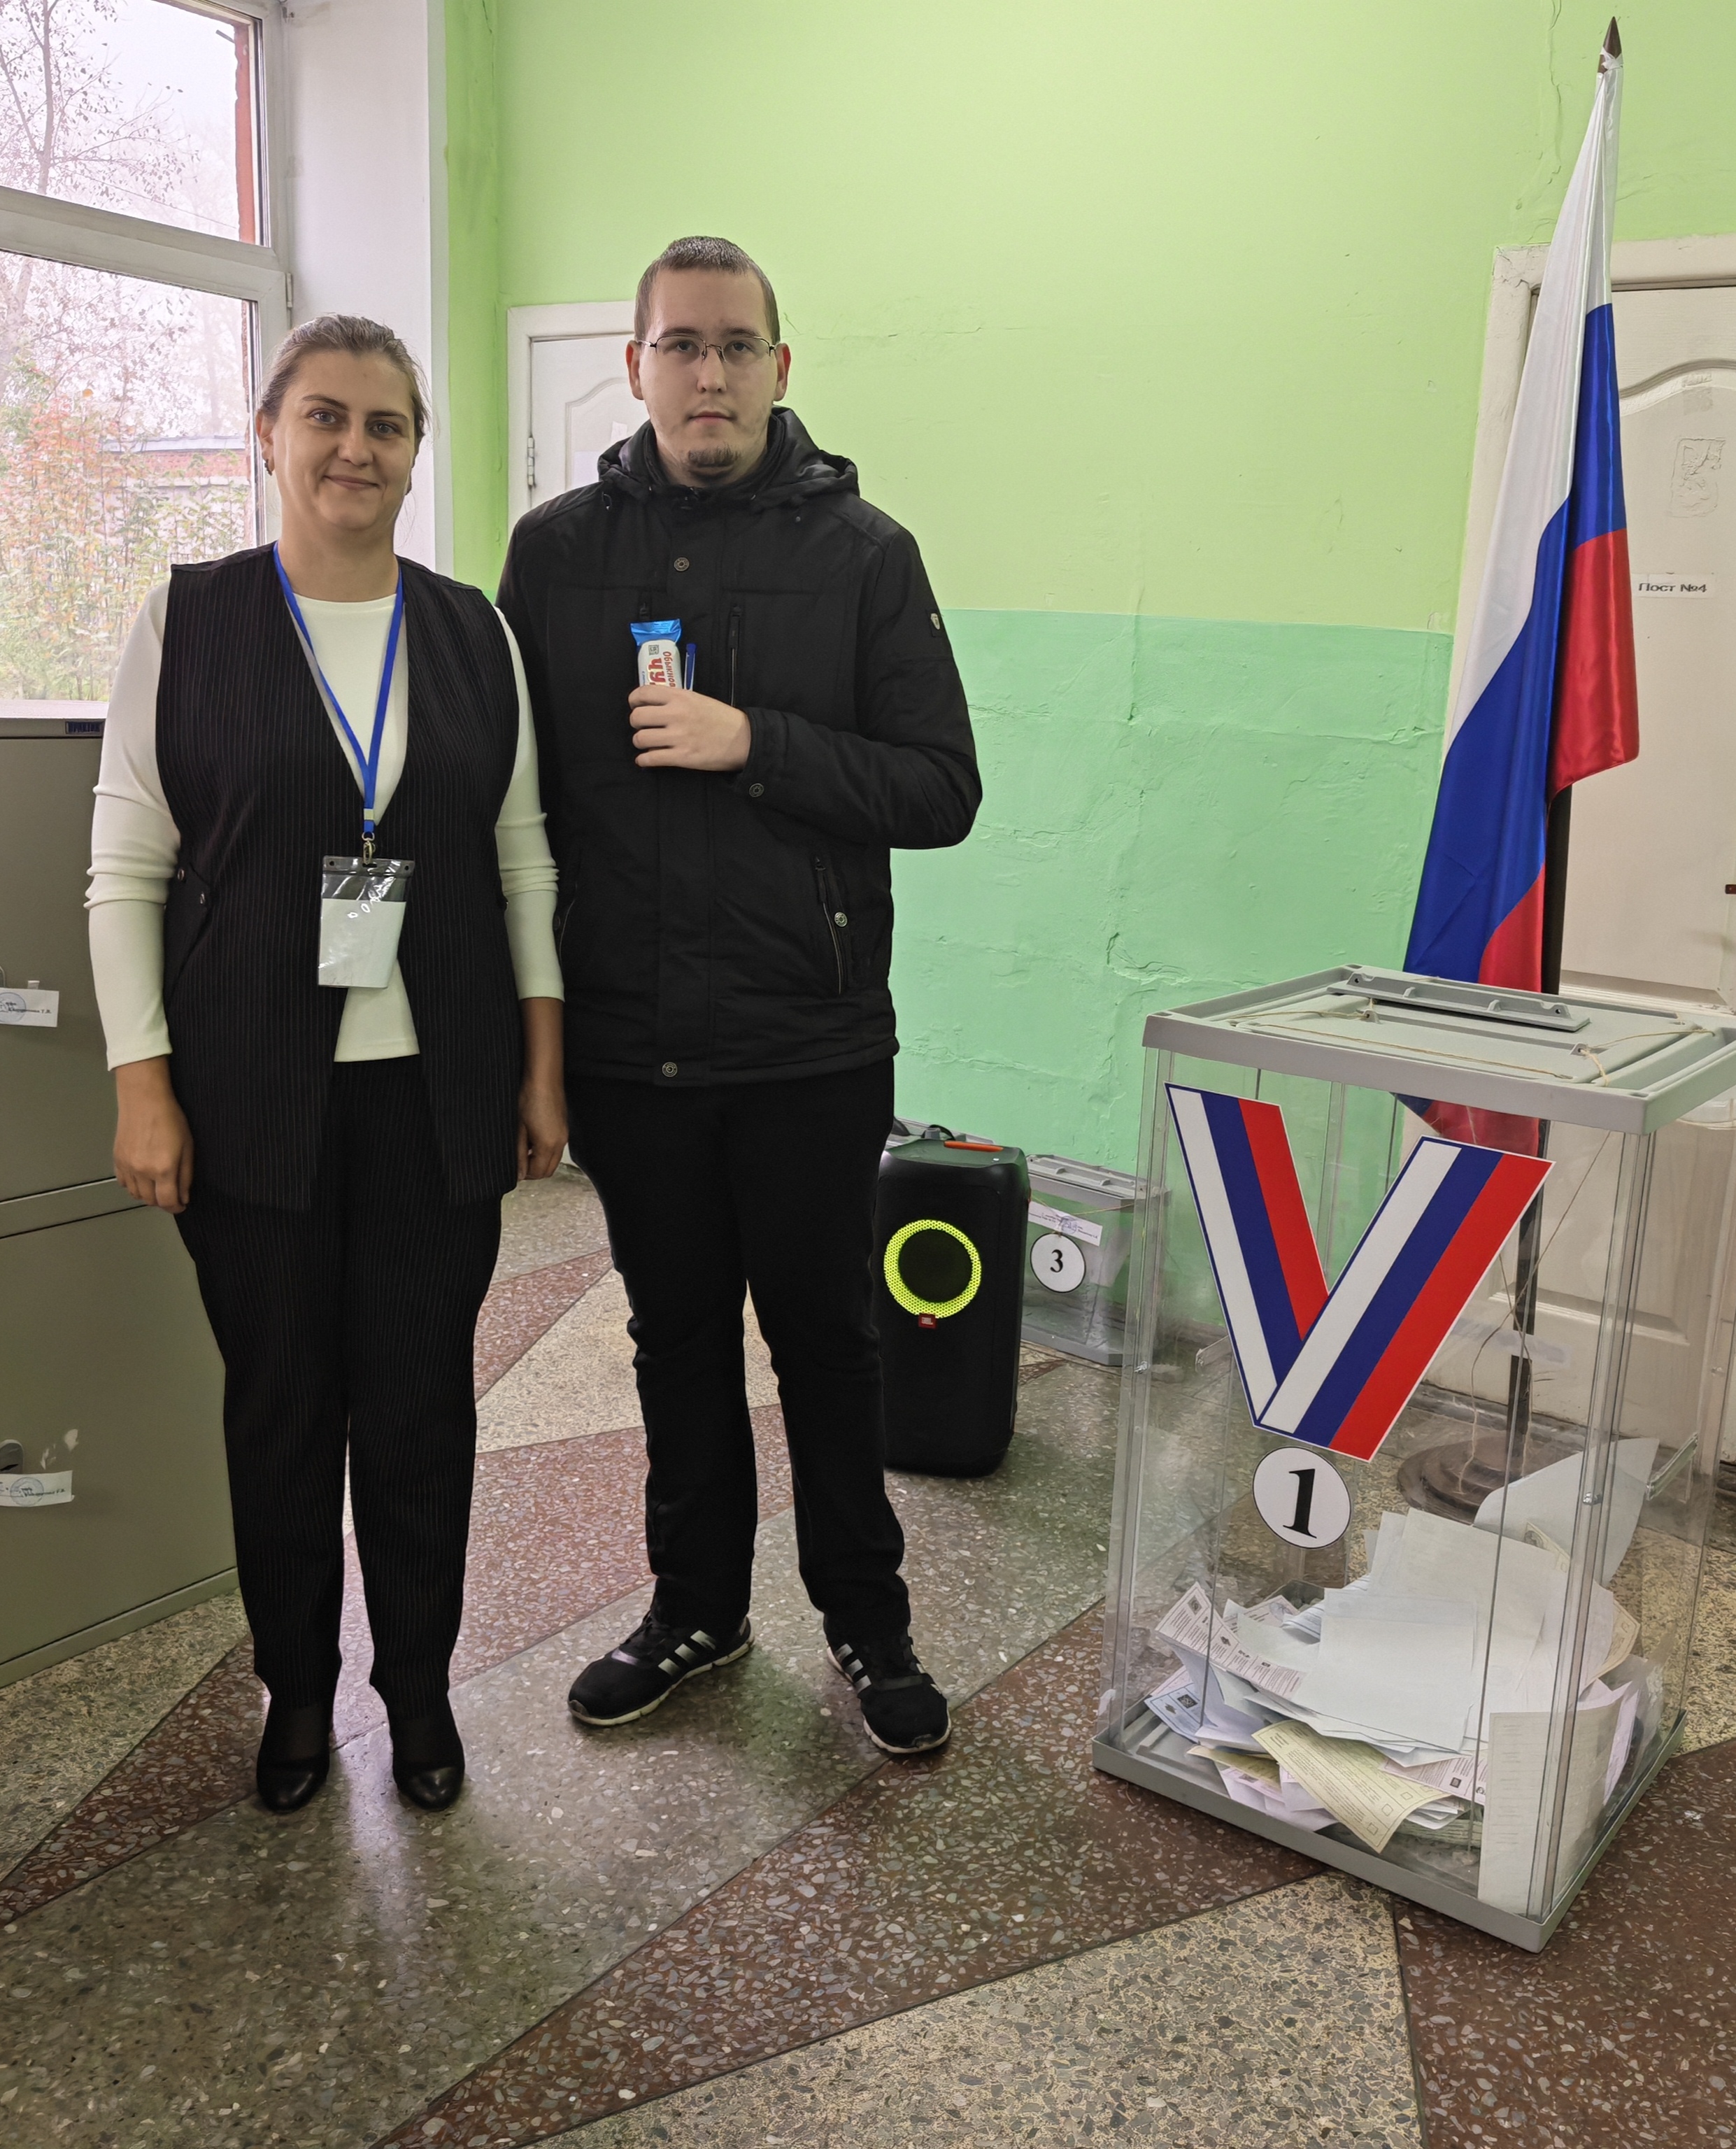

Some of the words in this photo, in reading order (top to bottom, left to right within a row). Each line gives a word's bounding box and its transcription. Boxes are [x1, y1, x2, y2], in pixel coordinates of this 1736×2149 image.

[1638, 583, 1676, 592] Пост
[1680, 583, 1707, 593] №4
[1050, 1249, 1064, 1273] 3
[1282, 1468, 1317, 1539] 1
